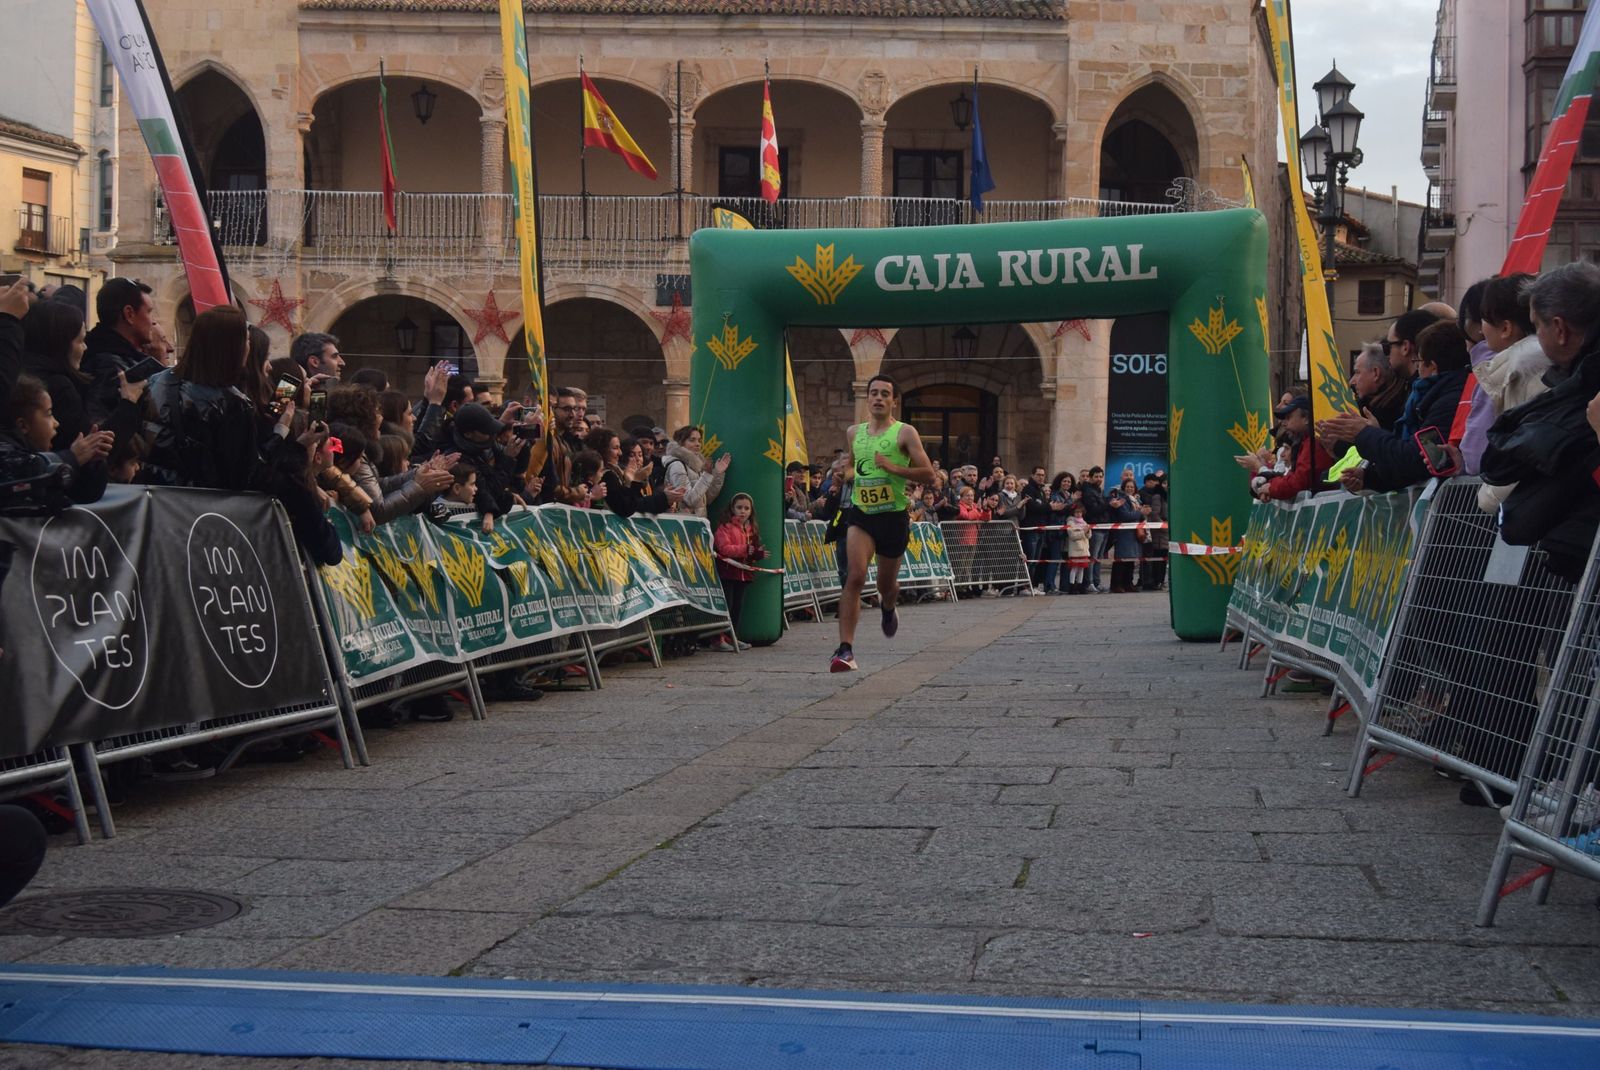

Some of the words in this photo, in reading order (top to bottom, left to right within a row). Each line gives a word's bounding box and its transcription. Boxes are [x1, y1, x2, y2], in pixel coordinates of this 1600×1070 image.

[874, 253, 985, 292] CAJA
[998, 244, 1158, 287] RURAL
[860, 487, 890, 504] 854
[61, 546, 109, 579] IM
[203, 546, 243, 575] IM
[45, 589, 137, 628] PLAN
[199, 585, 267, 615] PLAN
[371, 620, 405, 642] RURAL
[475, 609, 503, 628] RURAL
[74, 634, 133, 670] TES
[220, 624, 266, 654] TES
[359, 650, 373, 662] DE
[372, 640, 404, 658] ZAMORA
